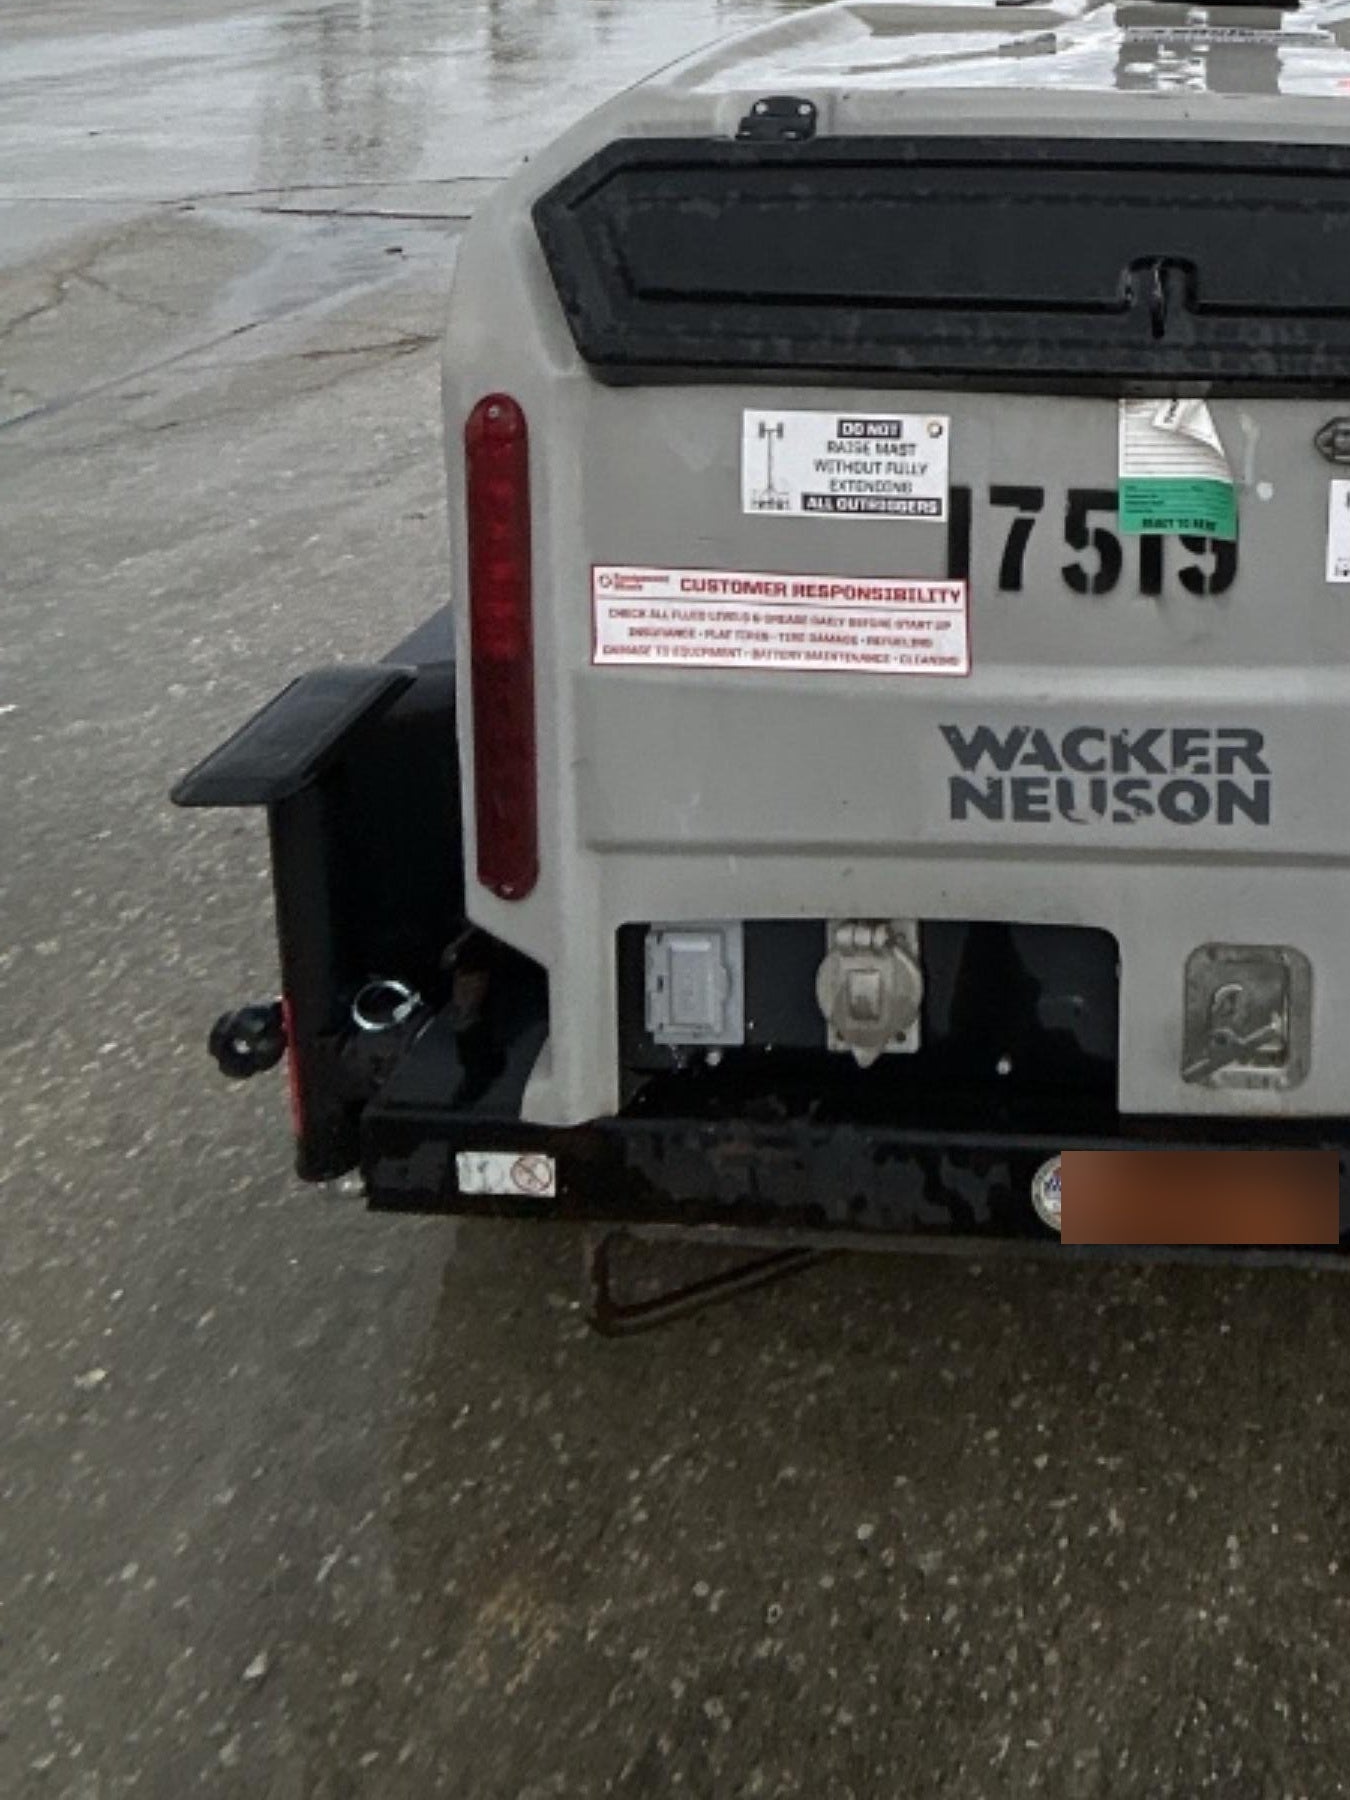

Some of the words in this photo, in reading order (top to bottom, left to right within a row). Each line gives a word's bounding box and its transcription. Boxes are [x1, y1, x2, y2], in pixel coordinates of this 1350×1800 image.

[842, 421, 864, 436] DO
[867, 422, 899, 437] NOT
[875, 442, 917, 457] MAST
[814, 459, 881, 475] WITHOUT
[885, 461, 928, 476] FULLY
[806, 497, 833, 511] ALL
[680, 578, 787, 598] CUSTOMER
[791, 583, 961, 604] RESPONSIBILITY
[939, 725, 1273, 776] WACKER
[948, 777, 1271, 826] NEUSON
